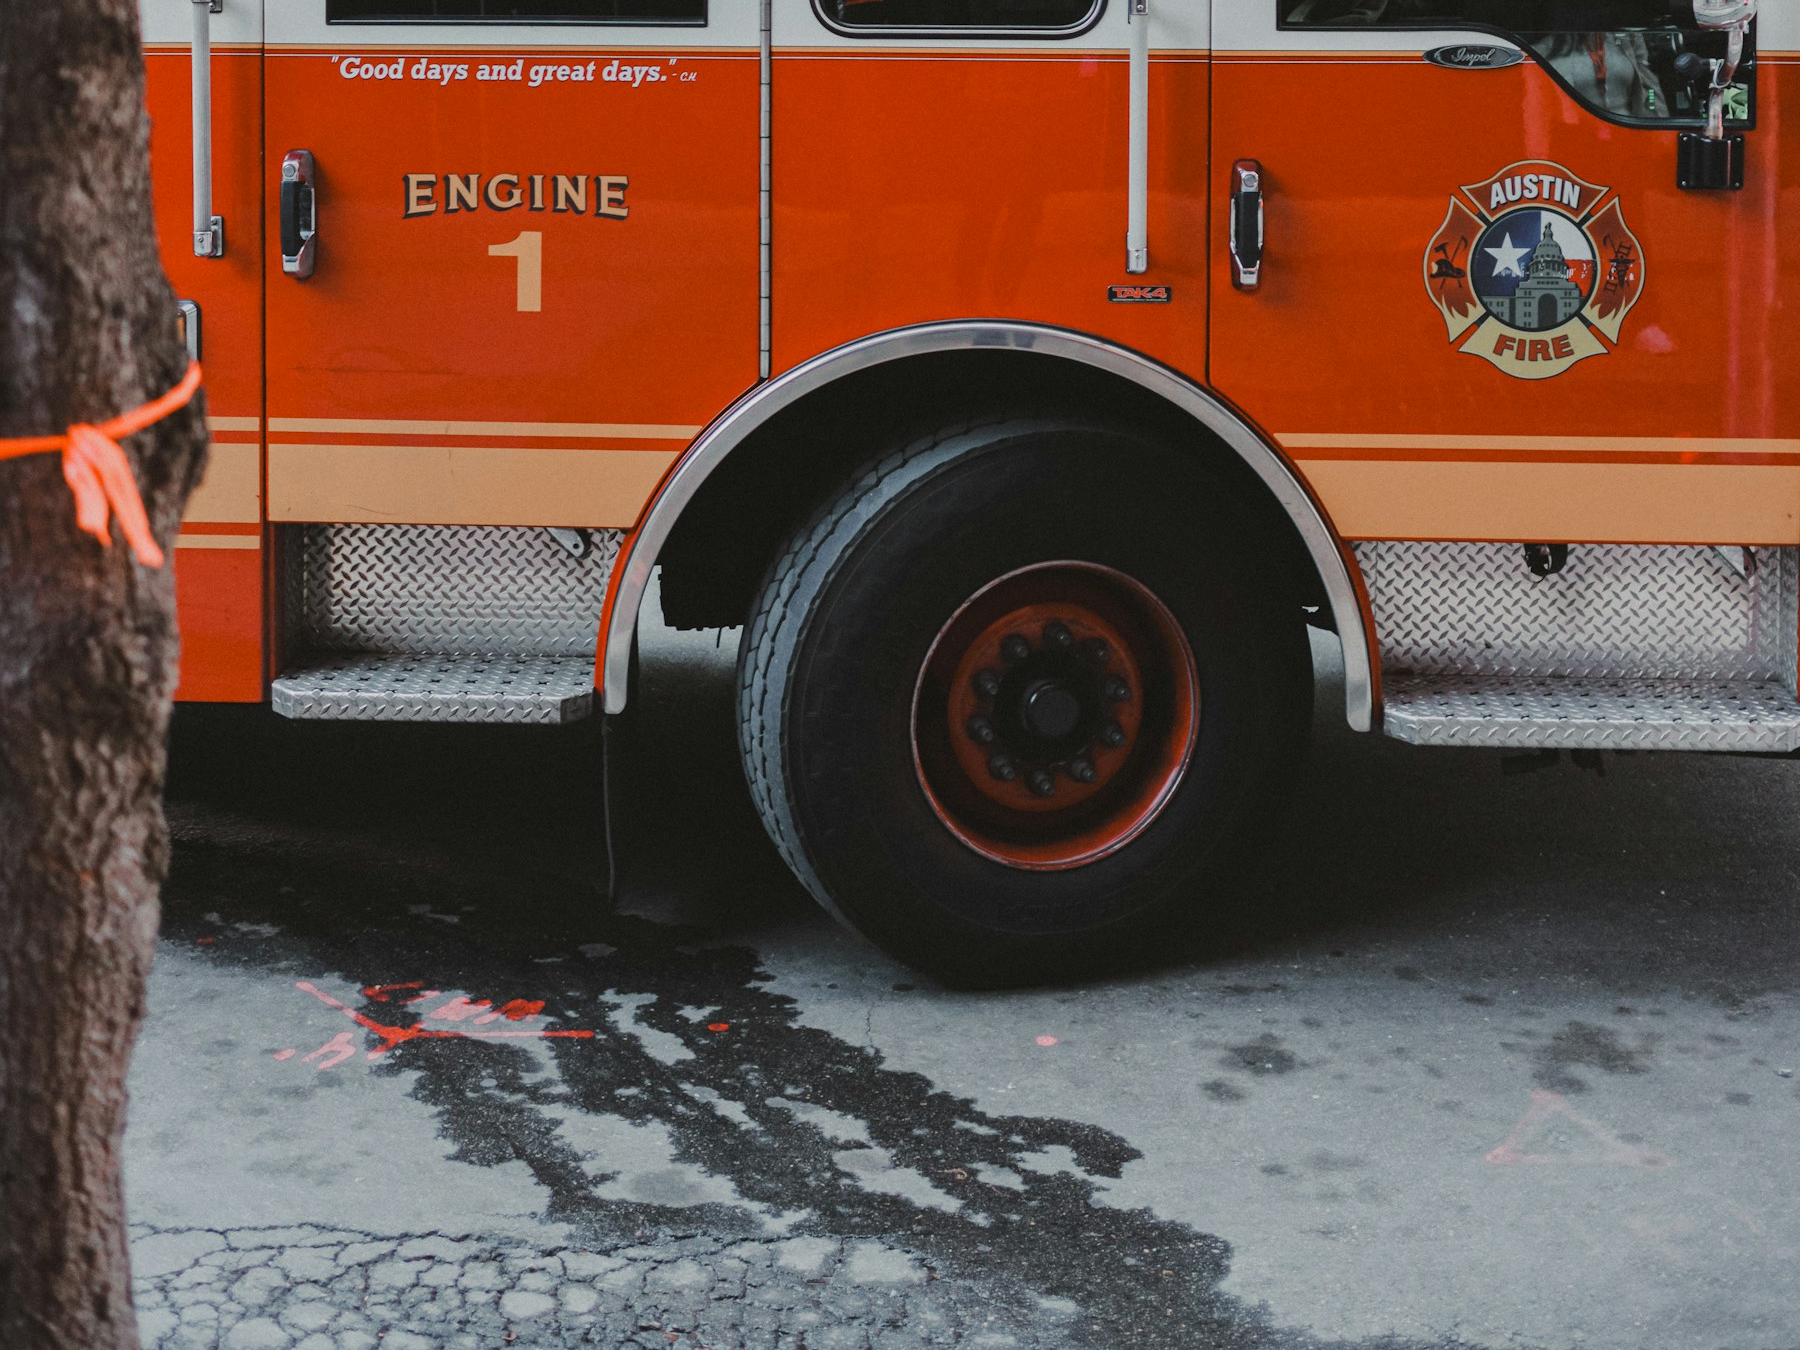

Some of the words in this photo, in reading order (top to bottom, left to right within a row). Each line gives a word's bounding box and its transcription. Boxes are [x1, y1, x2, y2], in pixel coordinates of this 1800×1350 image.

[331, 56, 405, 80] "Good
[411, 58, 468, 86] days
[476, 59, 524, 81] and
[528, 60, 596, 87] great
[602, 58, 677, 88] days."
[1451, 47, 1496, 66] Impel
[403, 173, 630, 220] ENGINE
[1490, 173, 1581, 210] AUSTIN
[488, 231, 542, 312] 1
[1493, 333, 1575, 362] FIRE
